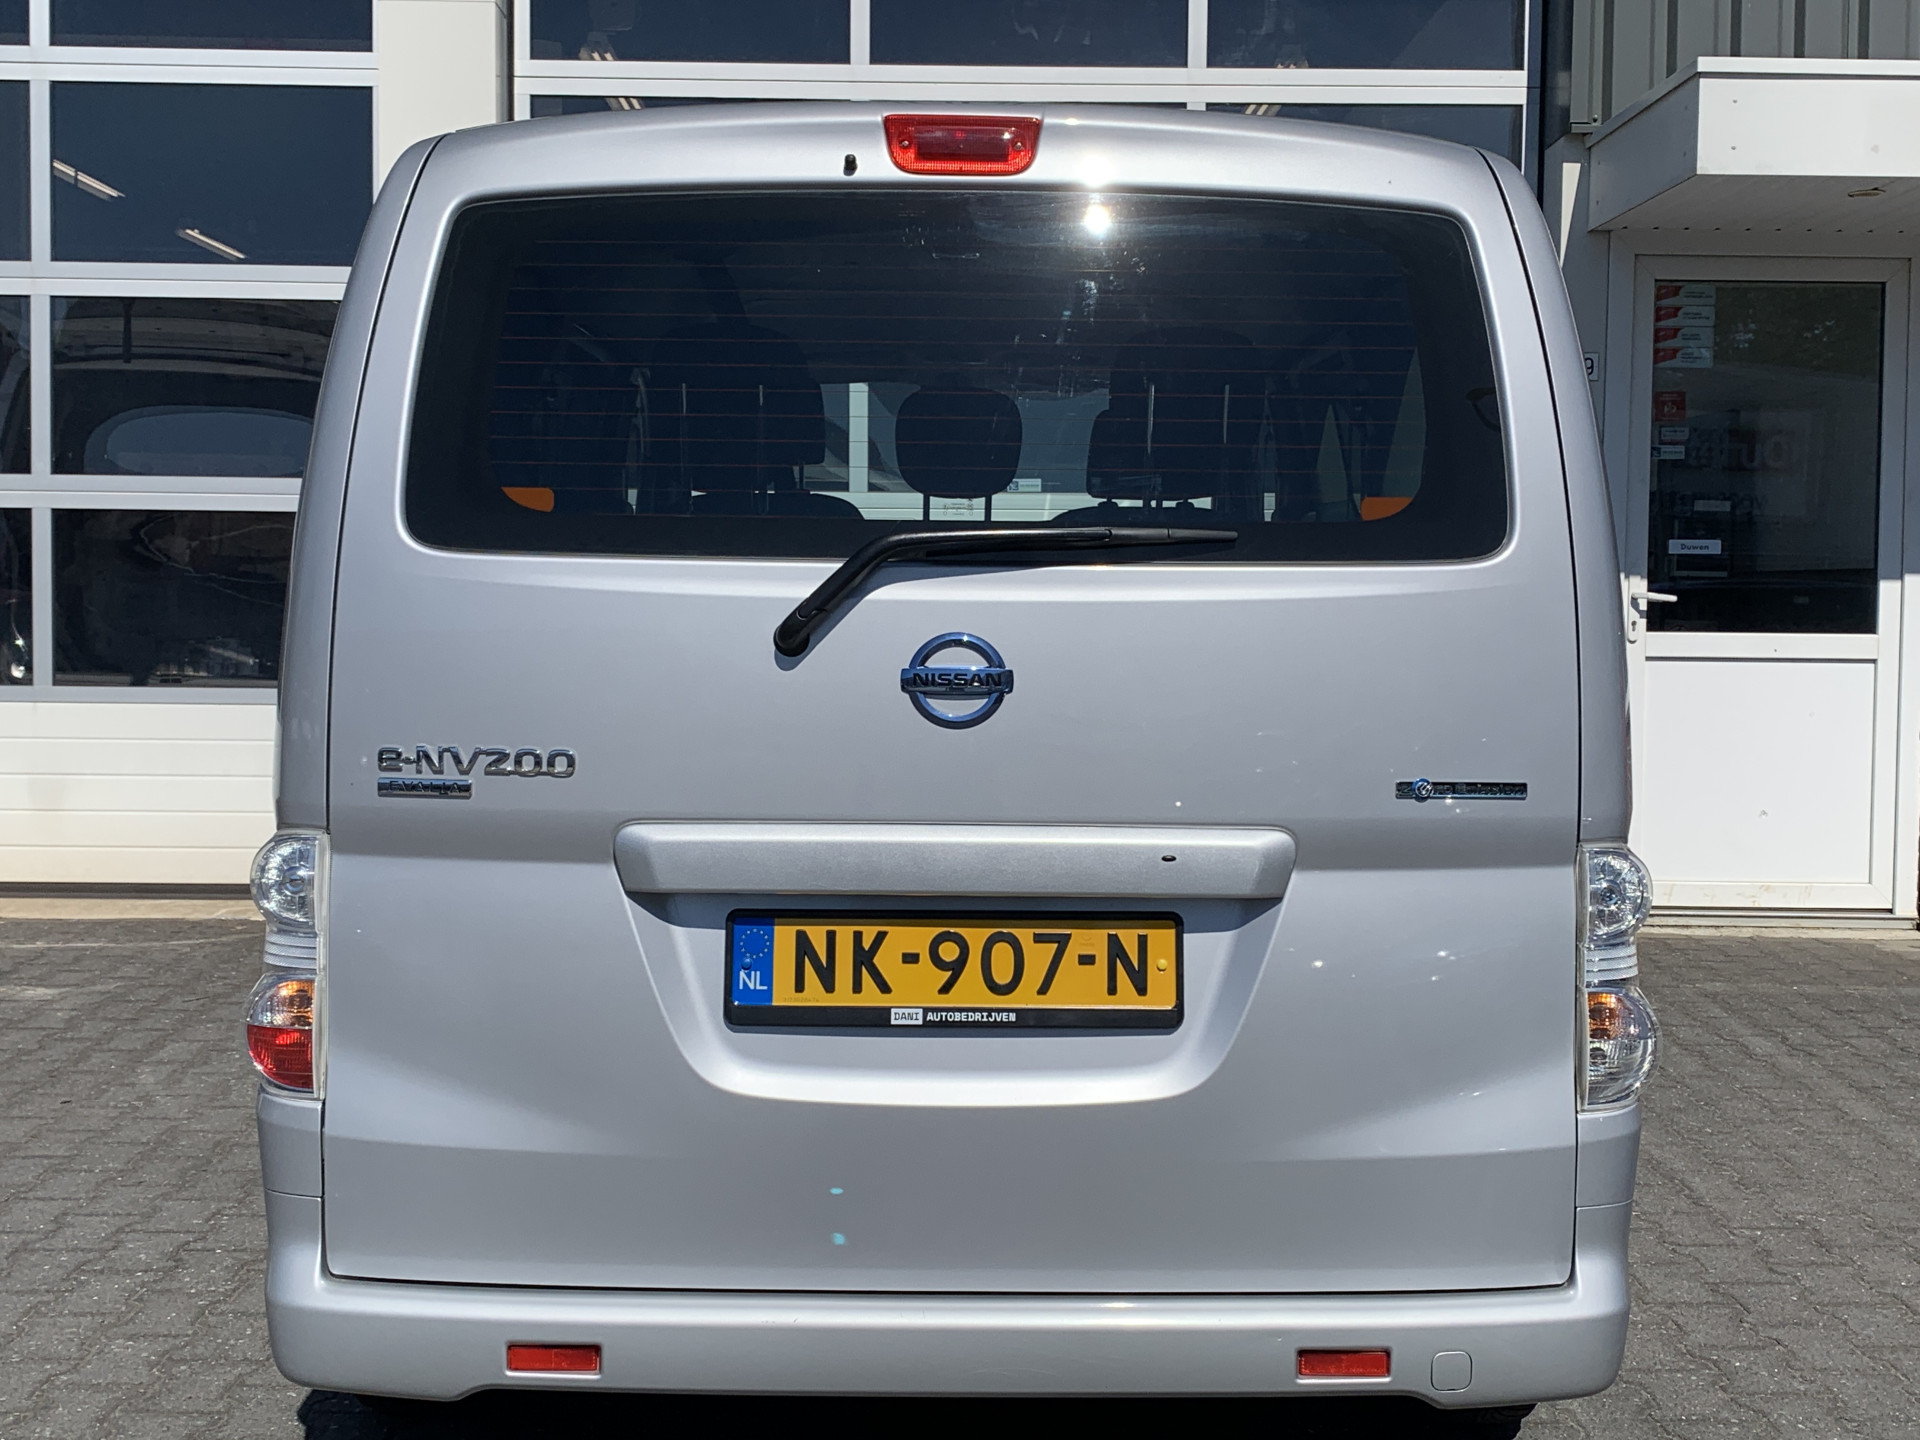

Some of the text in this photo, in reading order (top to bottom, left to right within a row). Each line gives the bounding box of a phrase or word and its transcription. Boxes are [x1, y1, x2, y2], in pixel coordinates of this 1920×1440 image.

[1680, 543, 1710, 551] Duwen
[912, 672, 1002, 687] NISSAN
[377, 743, 577, 778] e-NV200
[388, 780, 461, 795] EVALIA
[794, 929, 1149, 996] NK-907-N
[738, 970, 768, 991] NL
[893, 1011, 1017, 1022] DANI AUTOBEDRIJVEN
